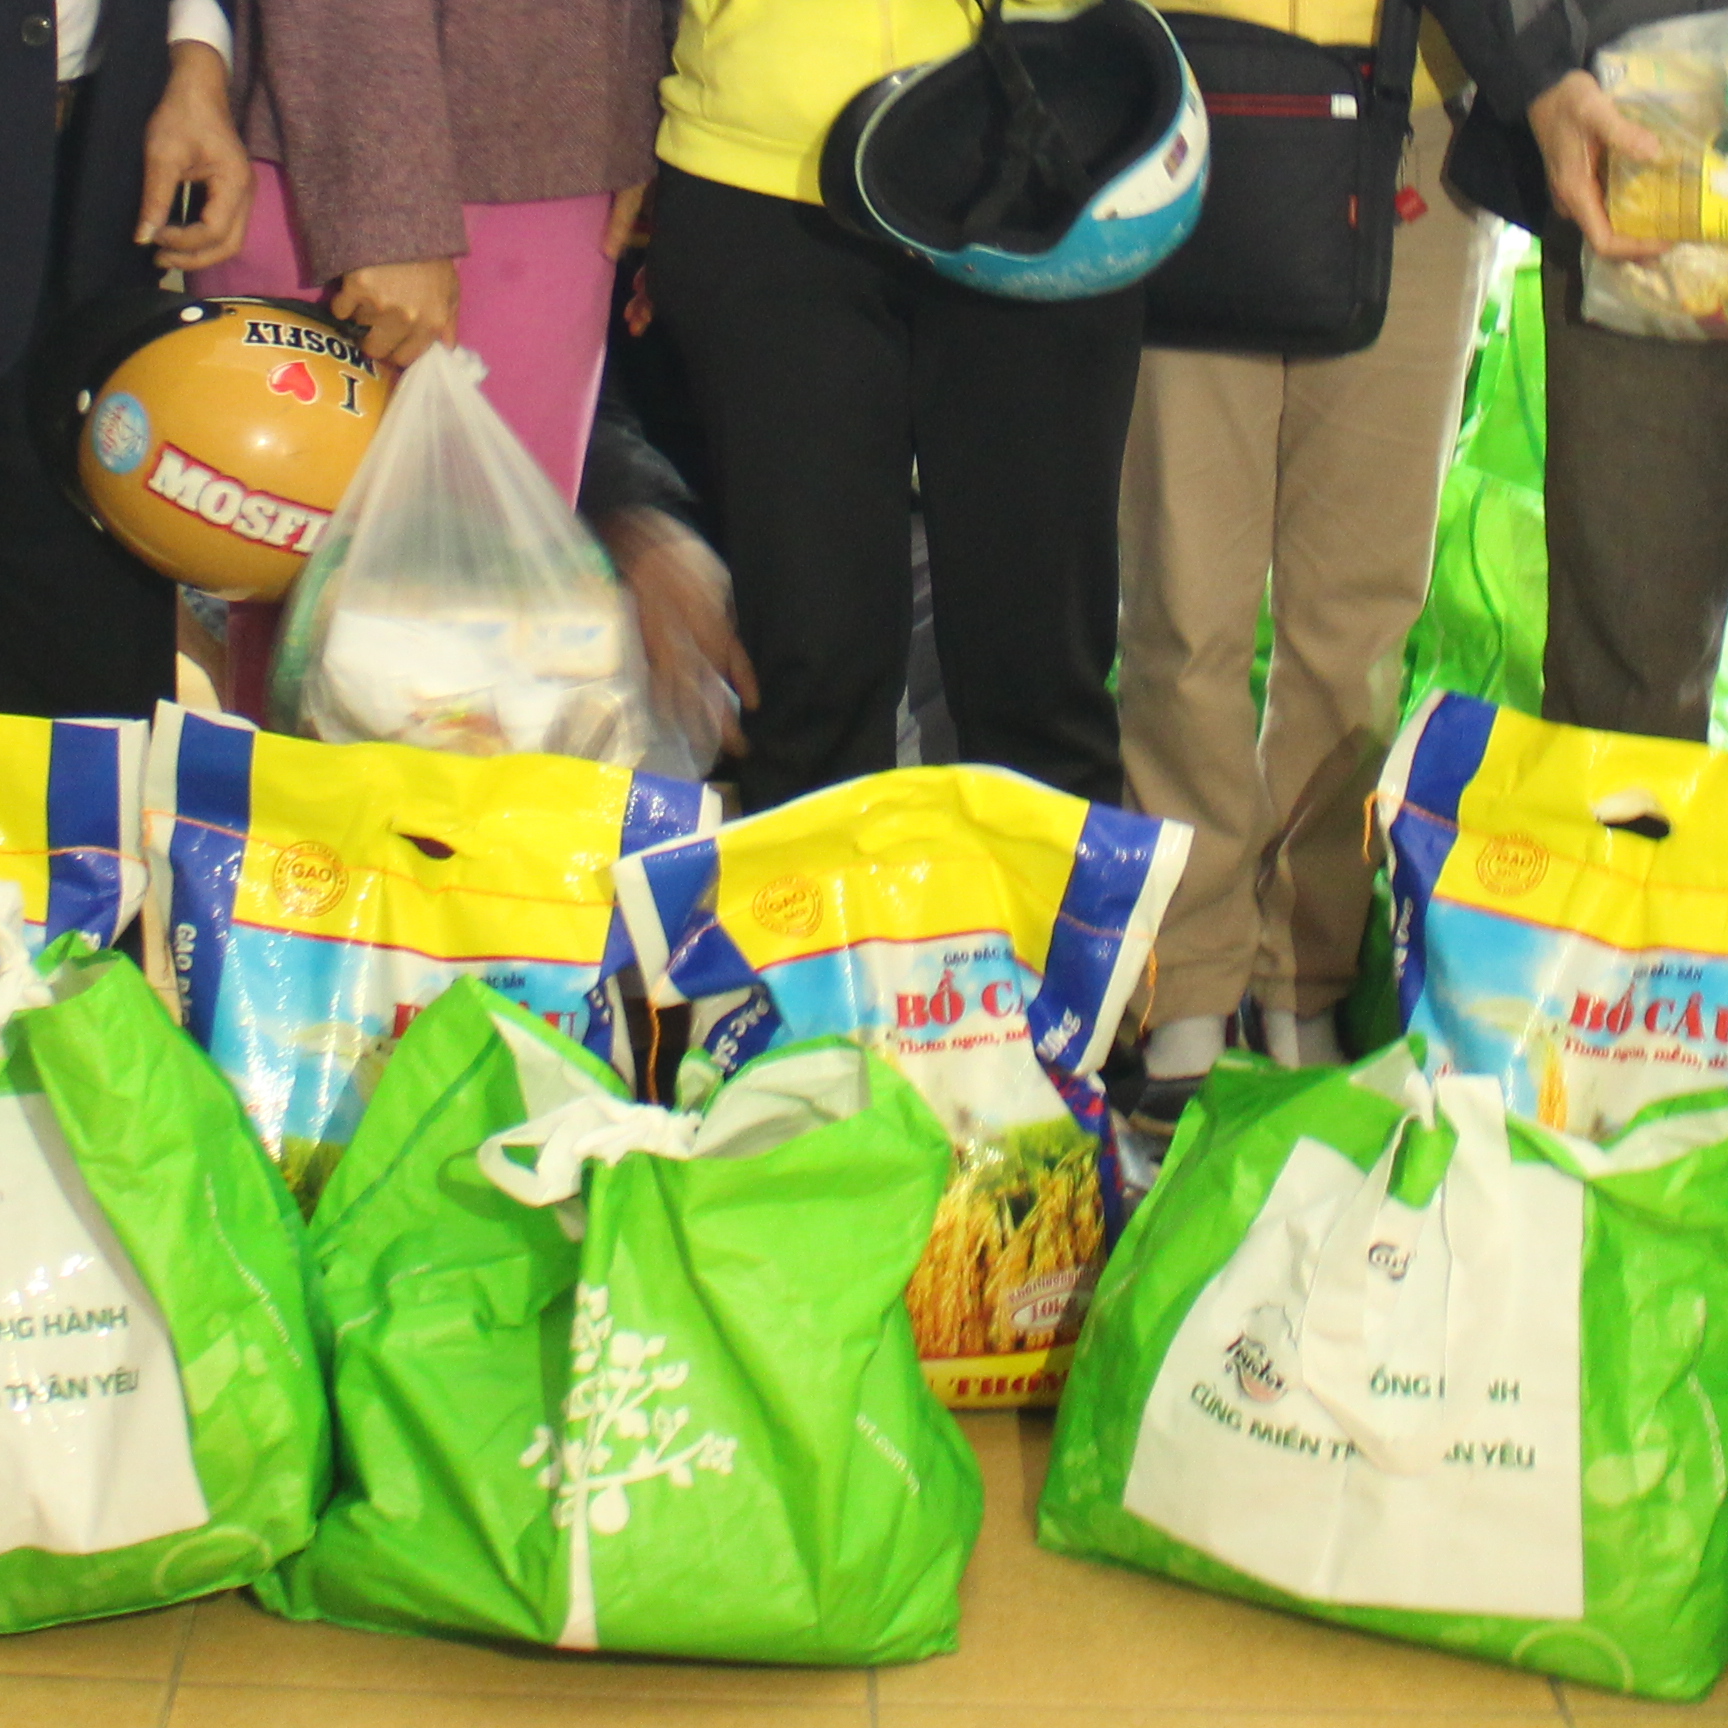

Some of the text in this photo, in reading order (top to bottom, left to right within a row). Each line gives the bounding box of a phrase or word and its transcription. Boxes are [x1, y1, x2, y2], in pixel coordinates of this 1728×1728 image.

[42, 1304, 130, 1337] HÀNH
[97, 1364, 140, 1398] YÊU
[1370, 1362, 1432, 1398] ỒNG
[1190, 1380, 1243, 1432] CÙNG
[1248, 1418, 1323, 1459] MIỀN
[1480, 1436, 1537, 1470] YÊU
